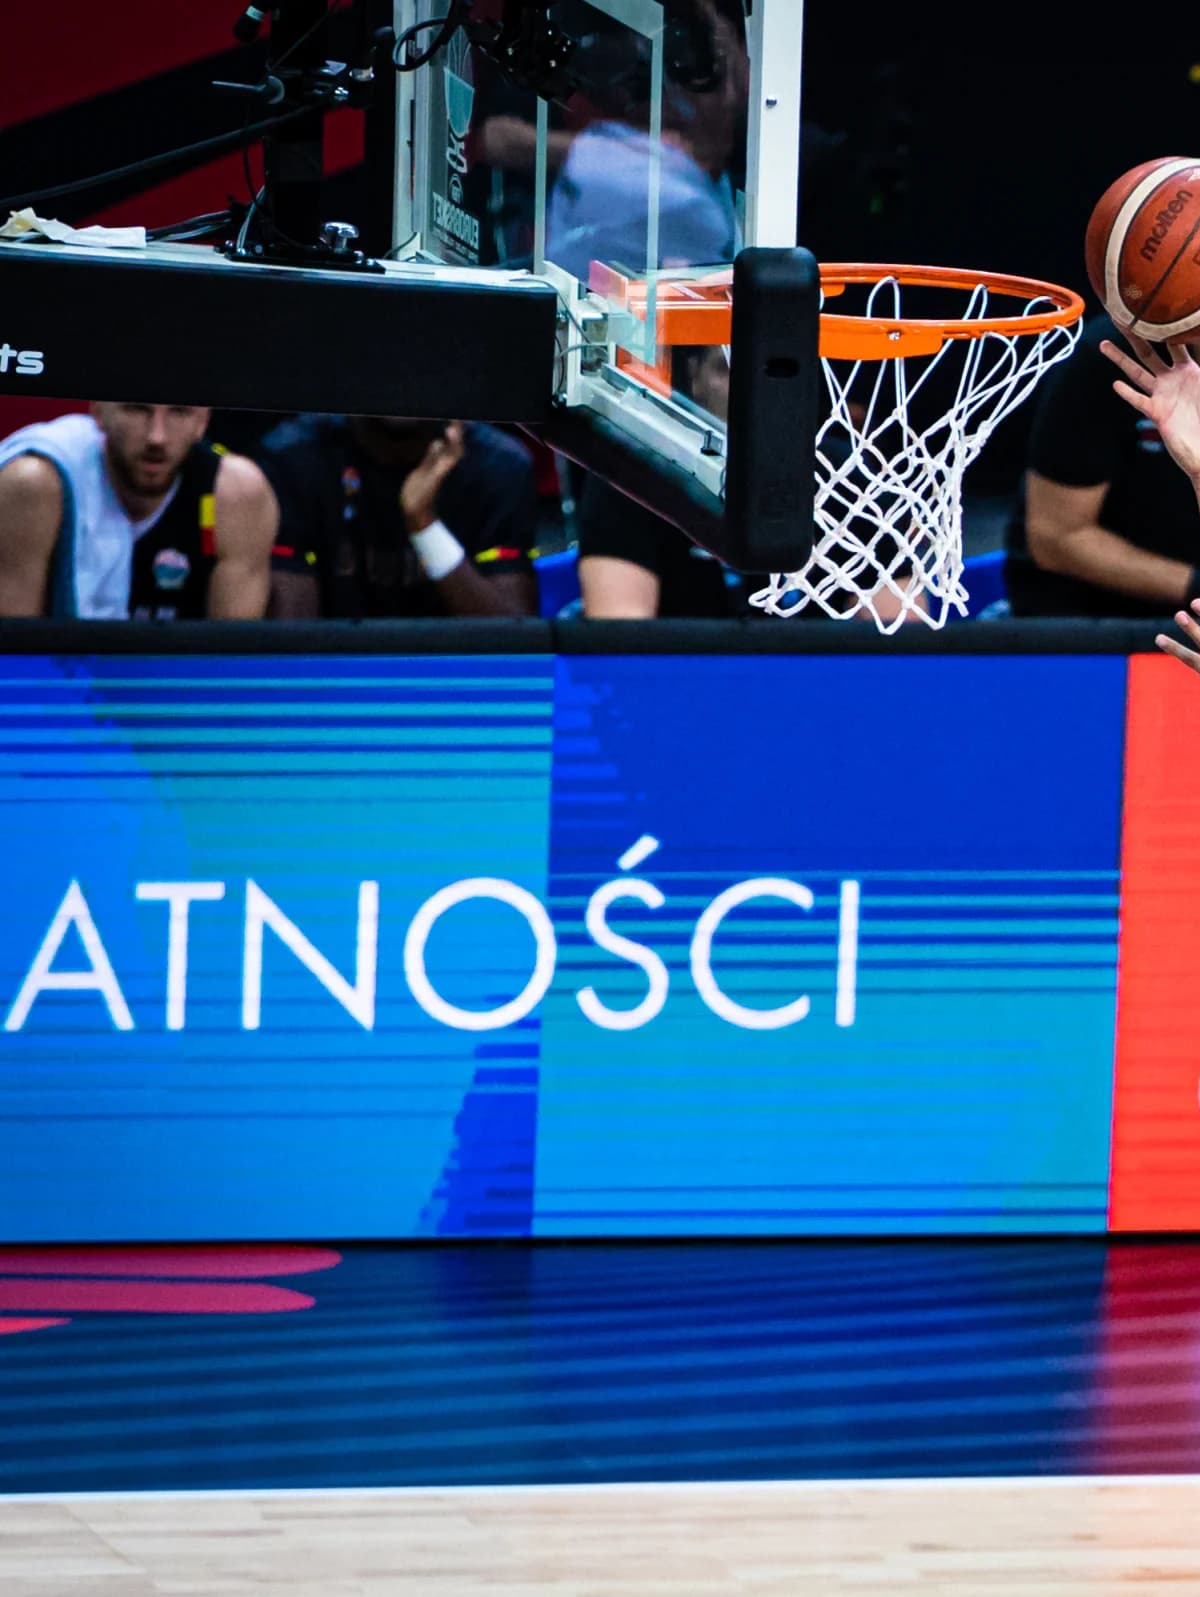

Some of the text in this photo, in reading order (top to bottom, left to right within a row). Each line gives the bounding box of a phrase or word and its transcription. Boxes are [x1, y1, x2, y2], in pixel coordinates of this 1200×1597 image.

[1141, 189, 1194, 262] molten
[0, 343, 44, 375] ts
[4, 835, 861, 1032] ATNOŚCI
